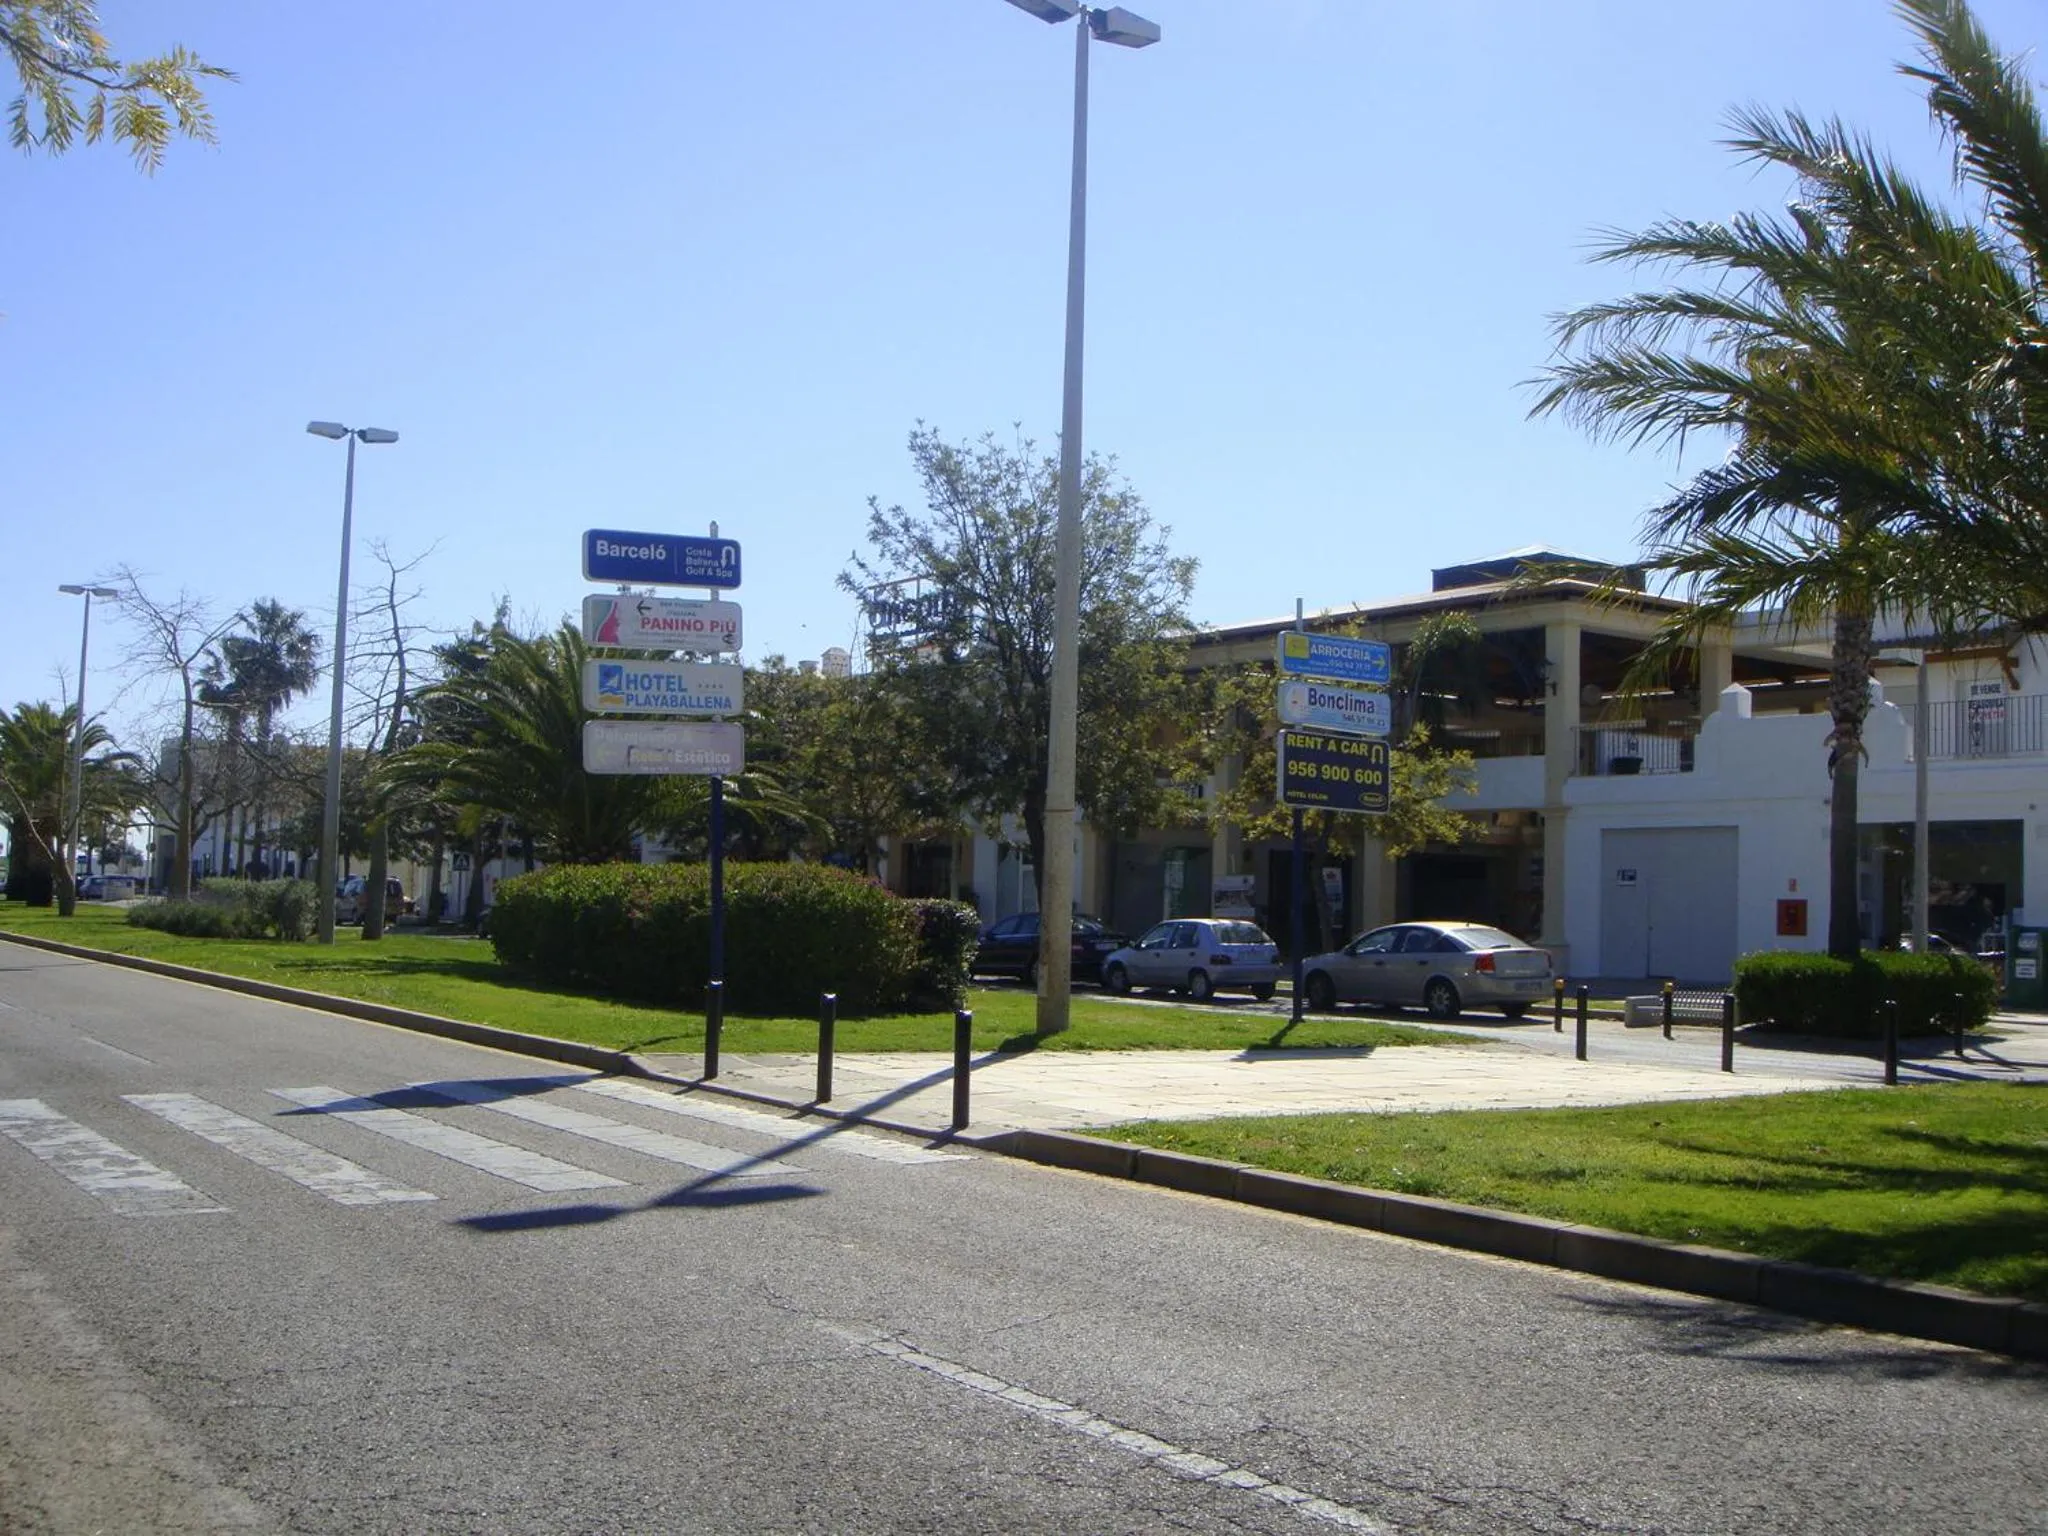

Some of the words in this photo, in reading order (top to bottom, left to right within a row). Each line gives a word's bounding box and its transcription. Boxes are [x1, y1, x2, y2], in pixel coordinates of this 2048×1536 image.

[595, 540, 667, 560] Barceló
[686, 547, 712, 558] Costa
[686, 566, 705, 577] Golf
[716, 569, 733, 578] Spa
[641, 617, 704, 633] PANINO
[626, 673, 688, 693] HOTEL
[626, 694, 732, 709] PLAYABALLENA
[1308, 687, 1375, 714] Bonclima
[1287, 734, 1324, 750] RENT
[1327, 739, 1338, 752] A
[1341, 741, 1369, 757] CAR
[1288, 760, 1317, 778] 956
[1321, 764, 1350, 782] 900
[1354, 768, 1382, 786] 600
